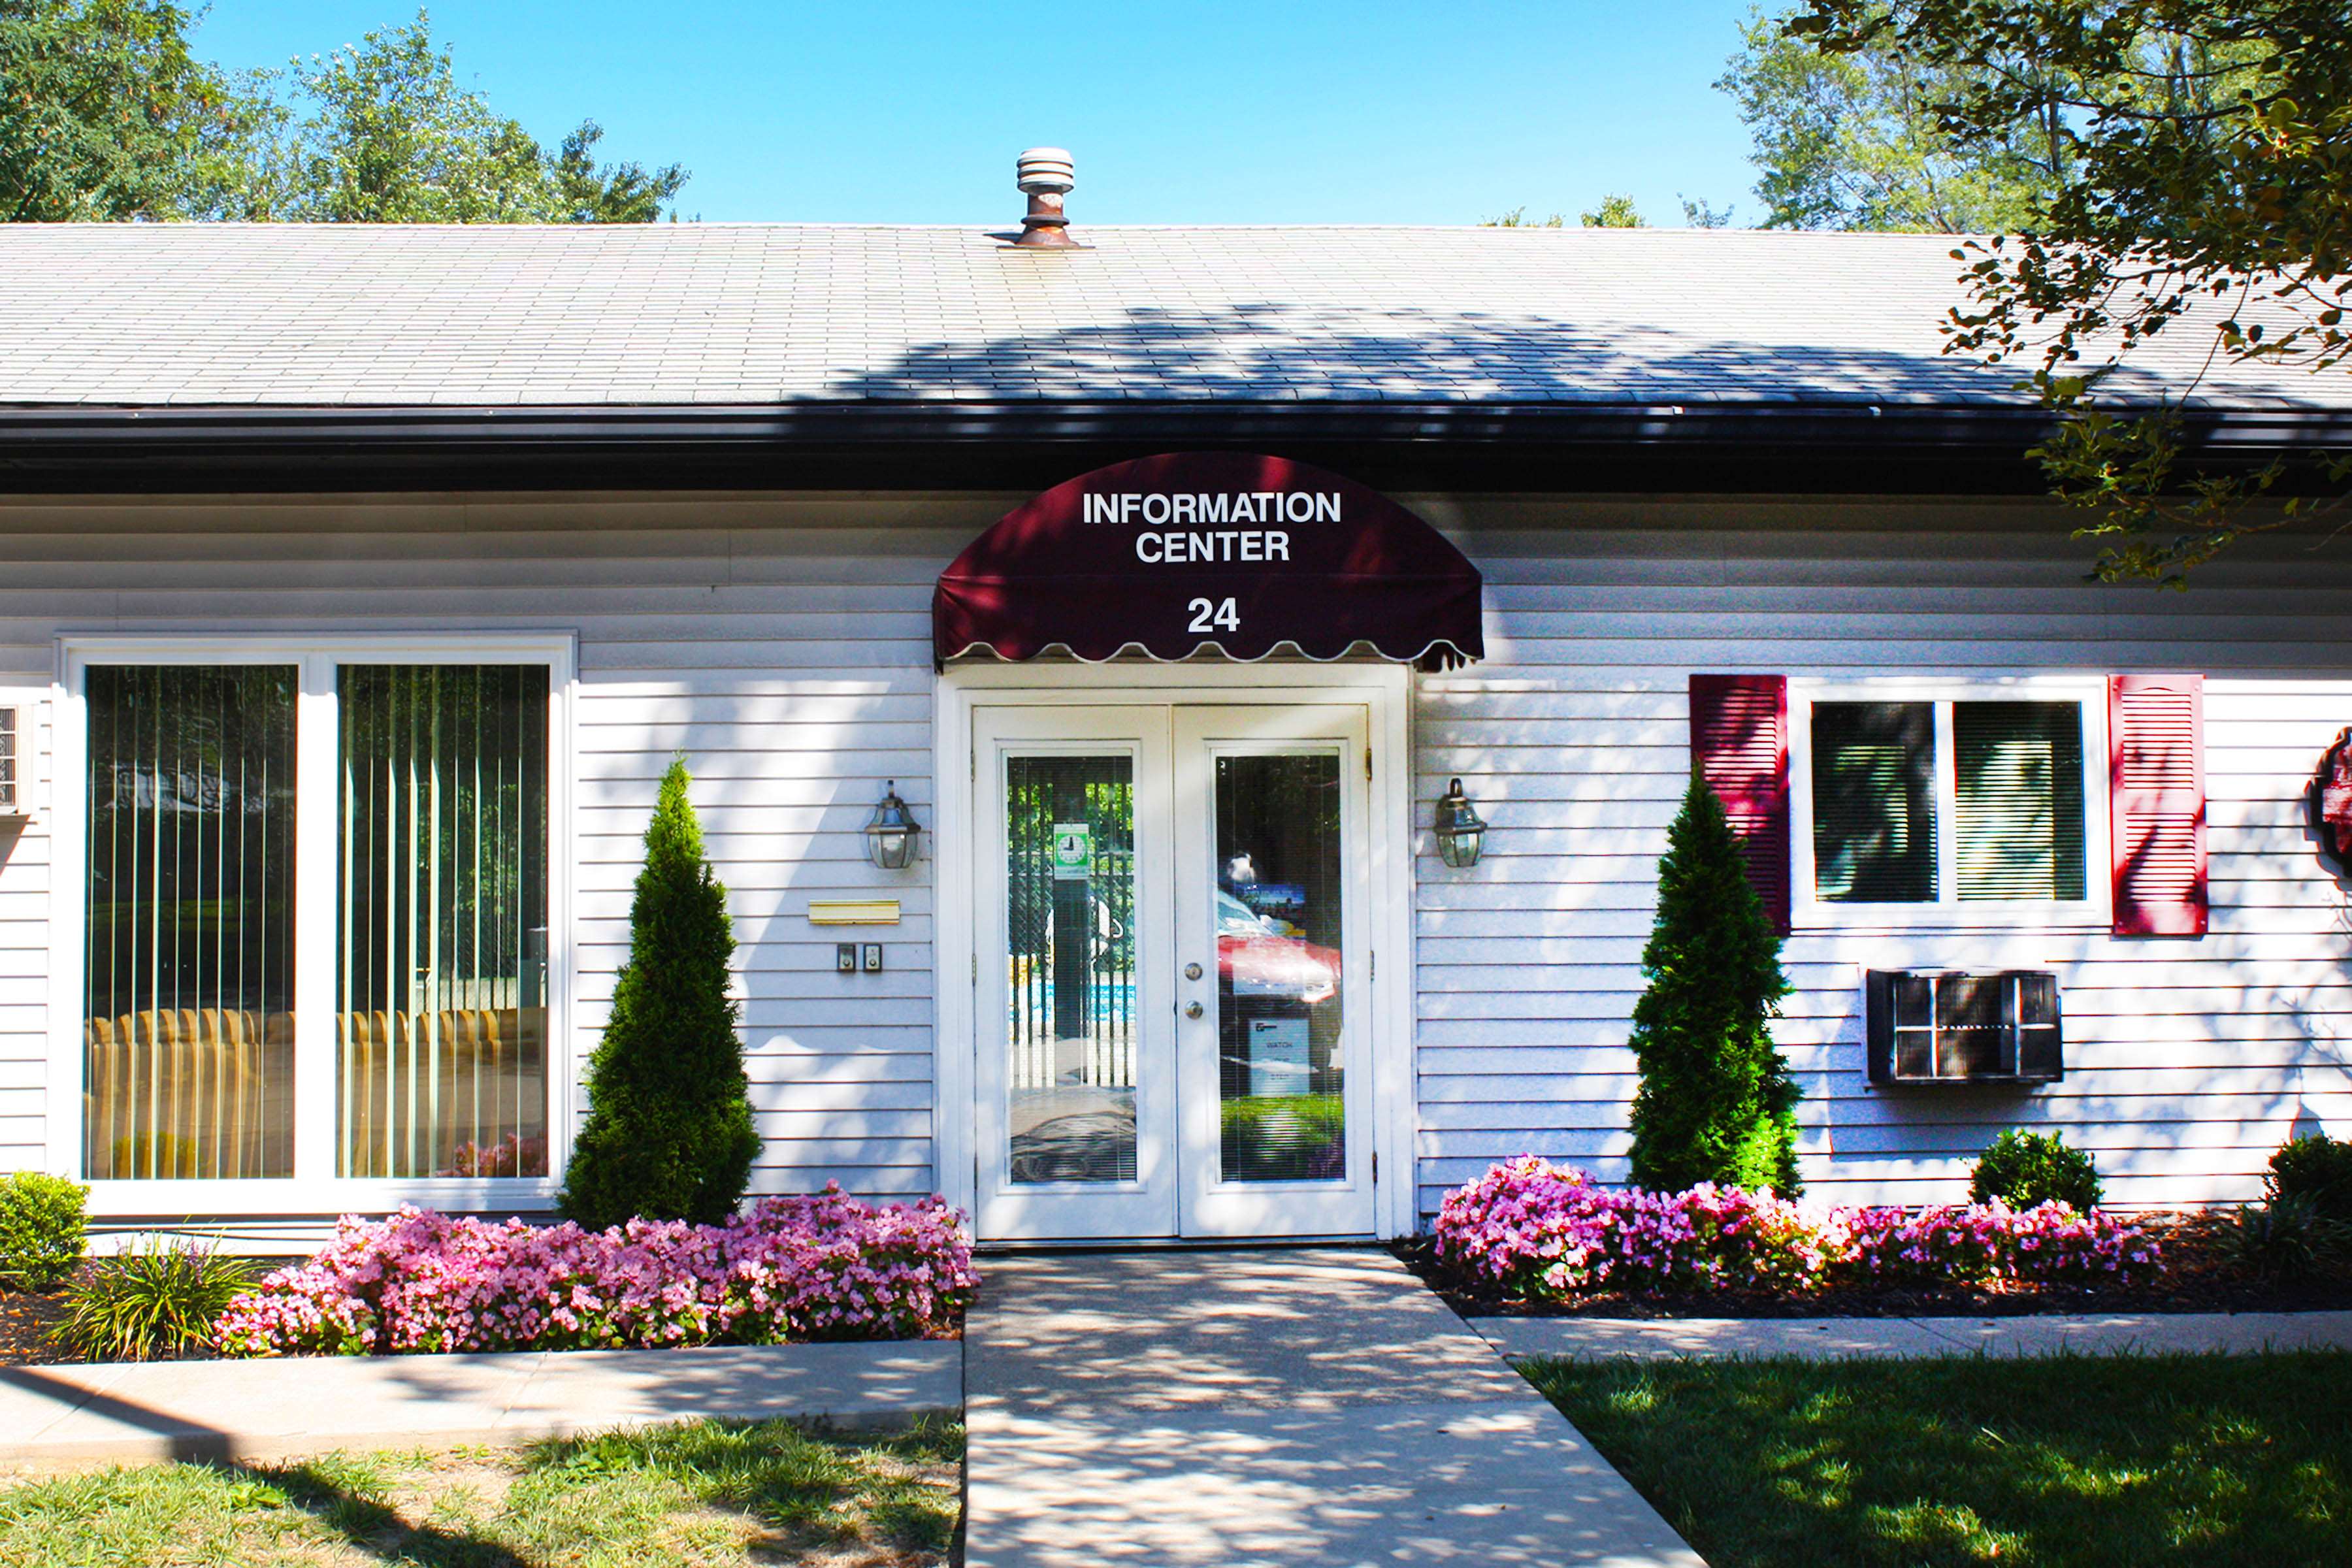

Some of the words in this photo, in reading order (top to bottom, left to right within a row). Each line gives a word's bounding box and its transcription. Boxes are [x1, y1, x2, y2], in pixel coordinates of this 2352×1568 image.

[1084, 492, 1341, 524] INFORMATION
[1136, 531, 1290, 563] CENTER
[1188, 597, 1241, 632] 24
